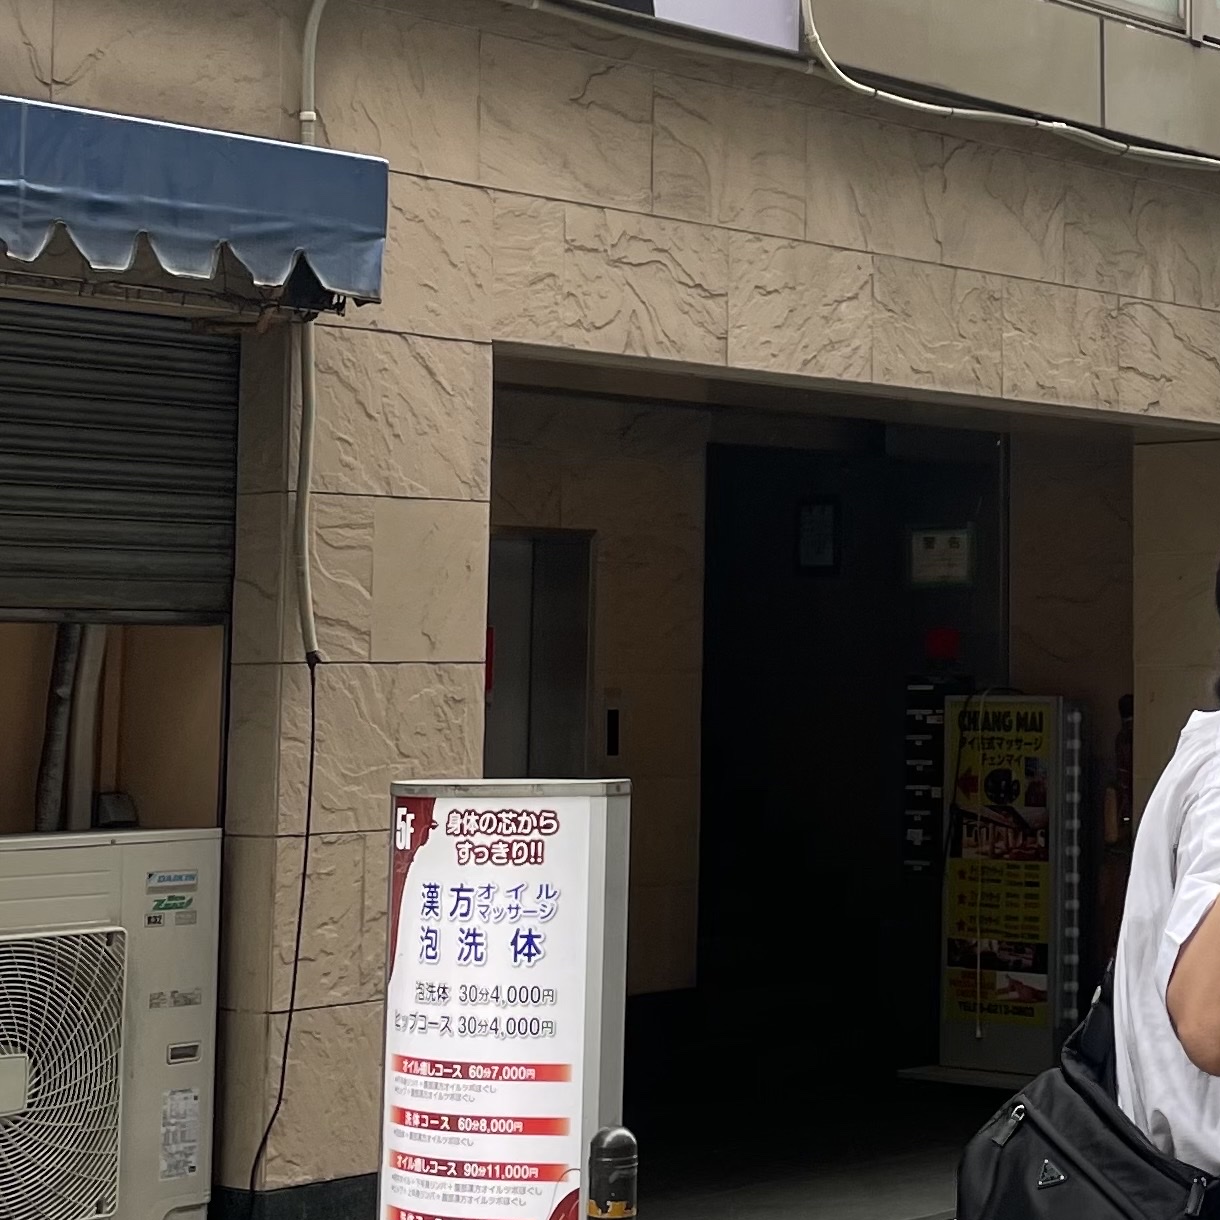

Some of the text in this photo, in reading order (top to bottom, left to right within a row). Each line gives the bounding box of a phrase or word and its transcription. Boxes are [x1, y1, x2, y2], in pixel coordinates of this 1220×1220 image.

[1016, 711, 1044, 733] MAI
[396, 807, 415, 850] 5F
[446, 809, 560, 836] 身体の芯から
[457, 841, 544, 866] すっきり!!
[421, 883, 474, 918] 漢方
[477, 883, 558, 900] オイル
[477, 904, 557, 921] マッサージ
[419, 925, 543, 963] 泡洗体
[416, 981, 555, 1005] 泡洗体 30分4,000円
[394, 1009, 555, 1037] ヒップコース 30分4,000円
[468, 1065, 536, 1081] 60分7,000円
[457, 1117, 524, 1134] 60分8,000円
[463, 1163, 539, 1180] 90分11,000円
